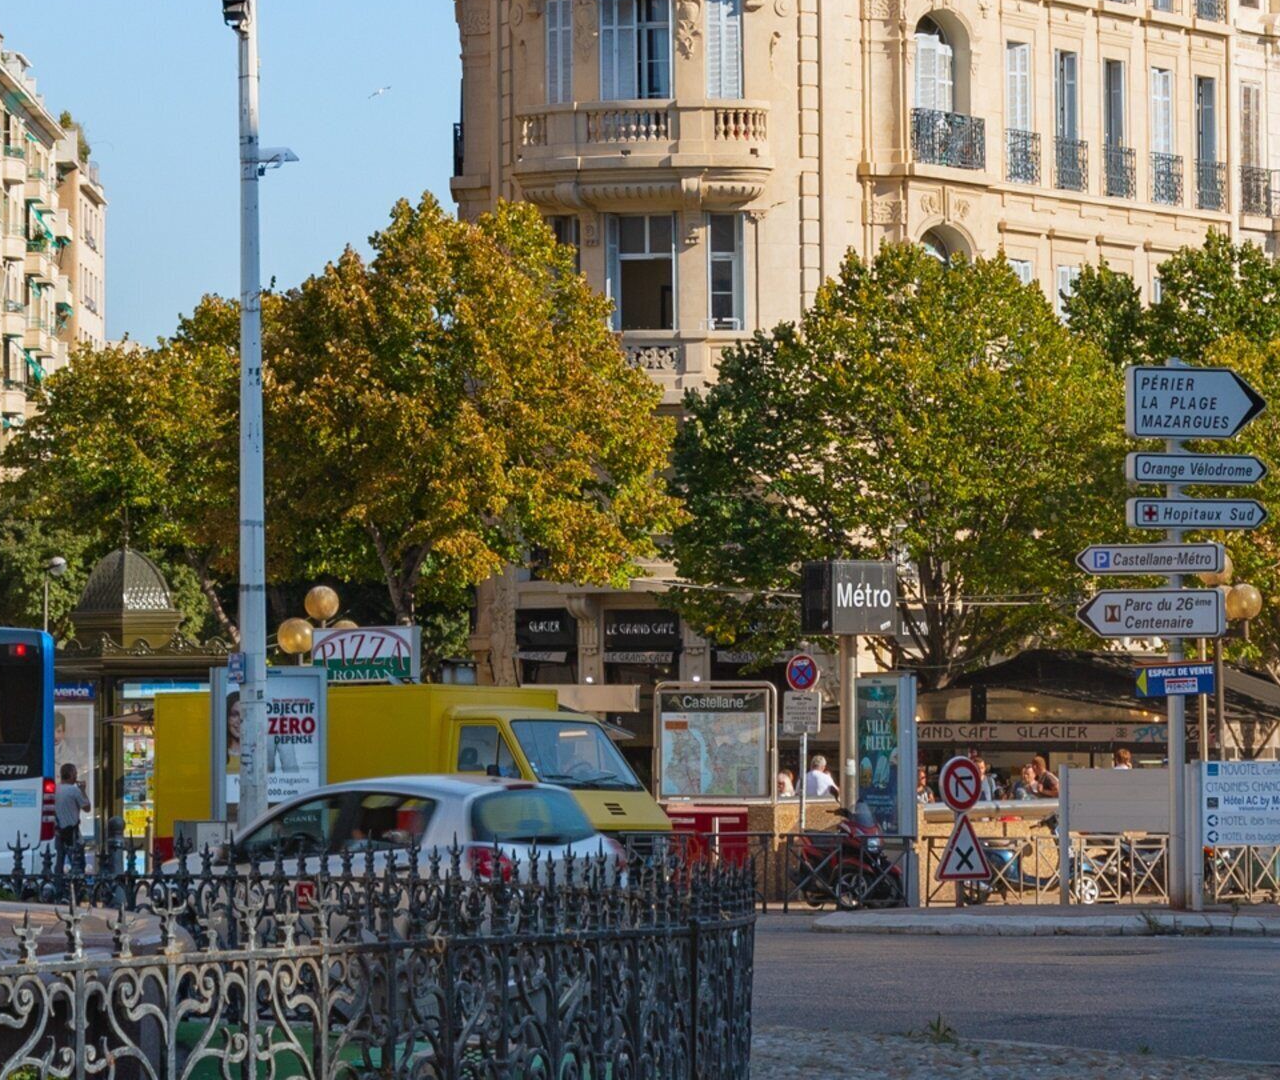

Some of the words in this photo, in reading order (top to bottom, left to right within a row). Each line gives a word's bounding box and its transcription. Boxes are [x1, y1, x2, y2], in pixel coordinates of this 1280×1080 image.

[1141, 374, 1195, 391] PÉRIER
[1141, 396, 1158, 409] LA
[1170, 396, 1218, 410] PLAGE
[1141, 414, 1230, 429] MAZARGUES
[1142, 461, 1185, 478] Orange
[1190, 462, 1253, 477] Vélodrome
[1163, 507, 1222, 523] Hopitaux
[1229, 507, 1255, 521] Sud
[1113, 552, 1212, 566] Castellane-Métro
[836, 582, 891, 608] Métro
[1124, 598, 1153, 611] Parc
[1157, 598, 1172, 611] du
[529, 621, 560, 633] GLACIER
[1124, 615, 1194, 629] Centenaire
[606, 623, 618, 635] LE
[619, 623, 650, 635] GRAND
[321, 634, 406, 671] PIZZA
[1148, 668, 1176, 678] ESPACE
[1178, 668, 1189, 676] DE
[1190, 666, 1213, 675] VENTE
[682, 695, 744, 708] Castellane
[266, 702, 315, 716] OBJECTIF
[1017, 726, 1088, 739] GLACIER
[1221, 764, 1261, 776] NOVOTEL
[278, 777, 310, 787] magasins
[1205, 781, 1250, 793] CITADINES
[1223, 795, 1245, 805] Hôtel
[1246, 796, 1258, 805] AC
[1260, 795, 1271, 807] by
[1220, 815, 1248, 826] HOTEL
[1250, 815, 1265, 826] ibis
[1222, 831, 1243, 841] HOTEL
